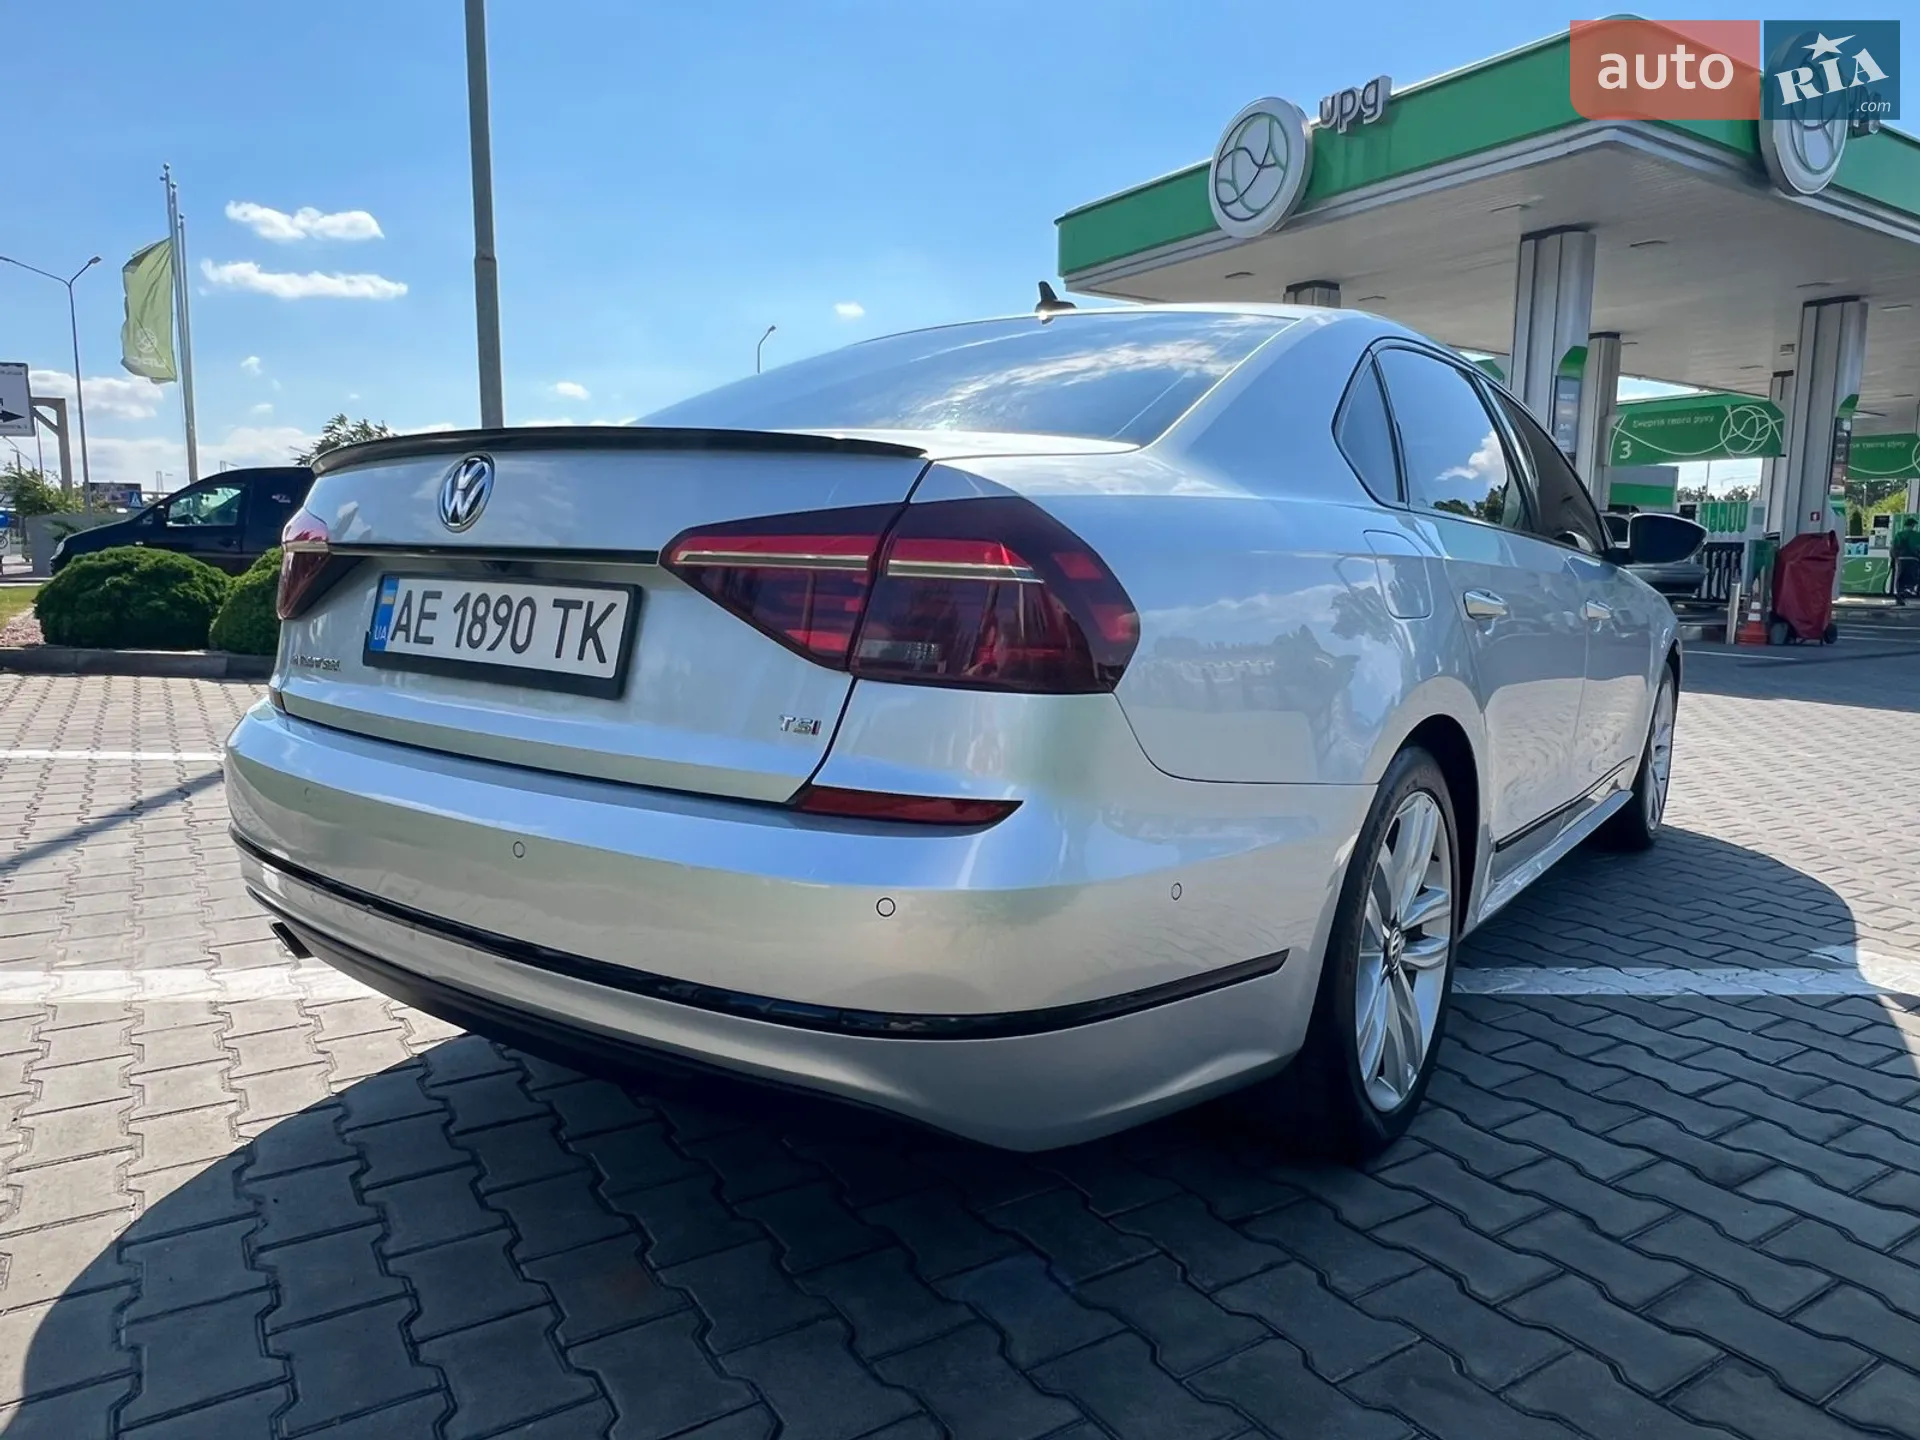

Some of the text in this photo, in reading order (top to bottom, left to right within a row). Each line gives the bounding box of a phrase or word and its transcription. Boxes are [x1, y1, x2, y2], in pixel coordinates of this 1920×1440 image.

[1319, 76, 1390, 134] upg
[1619, 441, 1632, 459] 3
[374, 626, 388, 641] UA
[390, 590, 617, 664] AE 1890 TK
[778, 714, 822, 736] TSI
